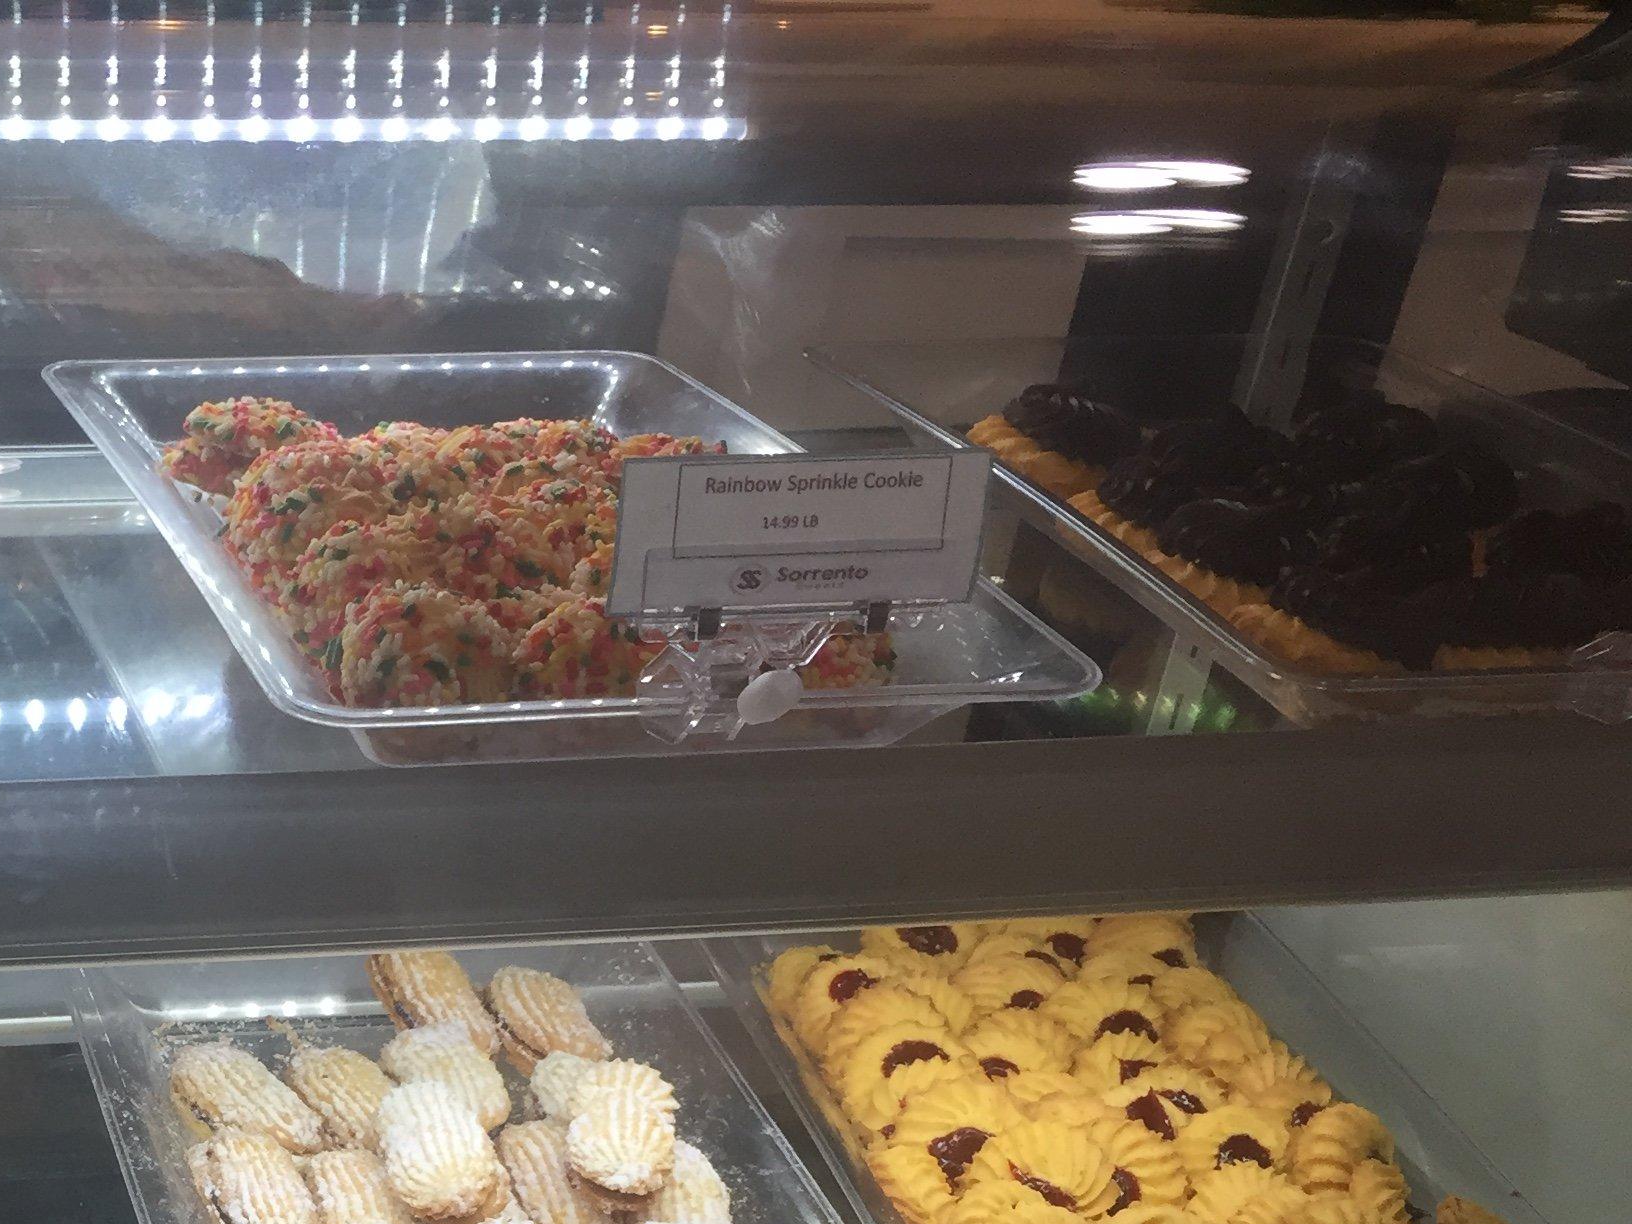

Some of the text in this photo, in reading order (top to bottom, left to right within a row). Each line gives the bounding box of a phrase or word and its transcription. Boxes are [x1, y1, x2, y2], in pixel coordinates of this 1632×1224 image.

[705, 471, 924, 495] Rainbow Sprinkle Cookie
[762, 514, 820, 530] 14.99 LB
[777, 564, 870, 583] Sorrento
